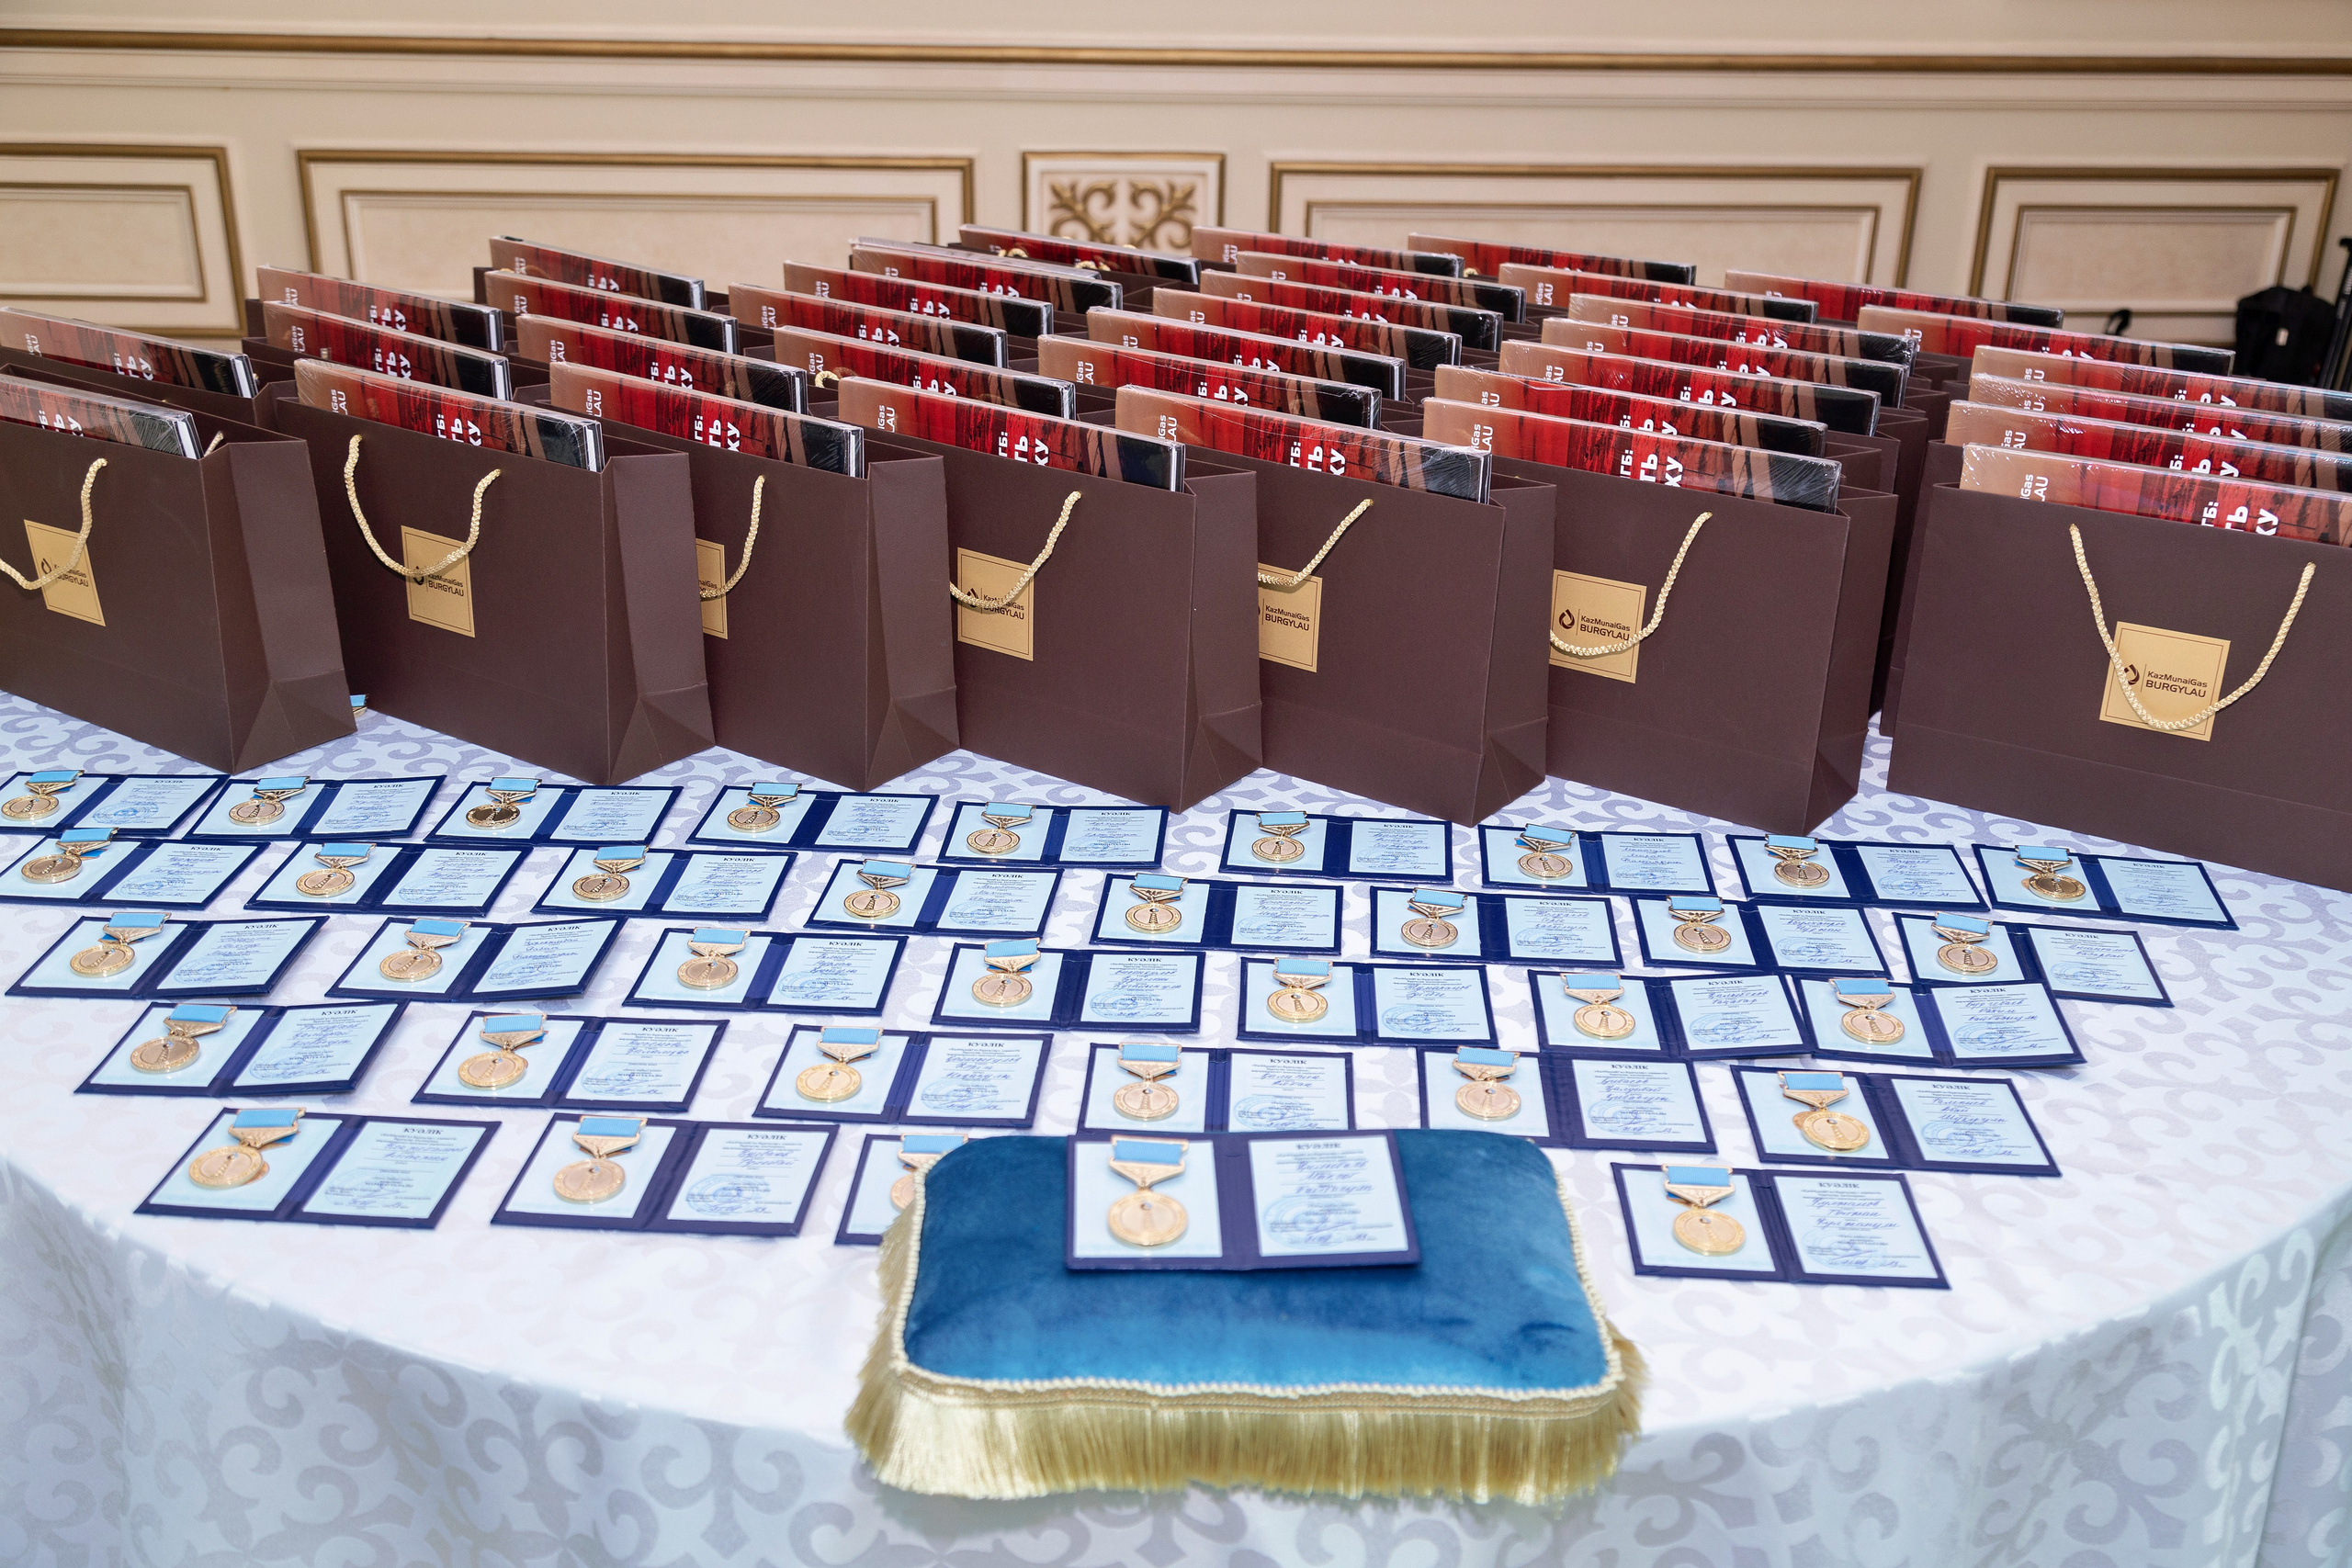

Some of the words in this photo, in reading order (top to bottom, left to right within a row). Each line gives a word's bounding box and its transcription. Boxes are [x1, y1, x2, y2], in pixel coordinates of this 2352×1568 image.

[428, 581, 465, 597] BURGYLAU
[1265, 604, 1310, 622] KazMunaiGas
[1265, 614, 1310, 631] BURGYLAU
[1580, 615, 1631, 632] KazMunaiGas
[1579, 624, 1630, 641] BURGYLAU
[2147, 671, 2208, 688] KazMunaiGas
[2145, 679, 2207, 698] BURGYLAU
